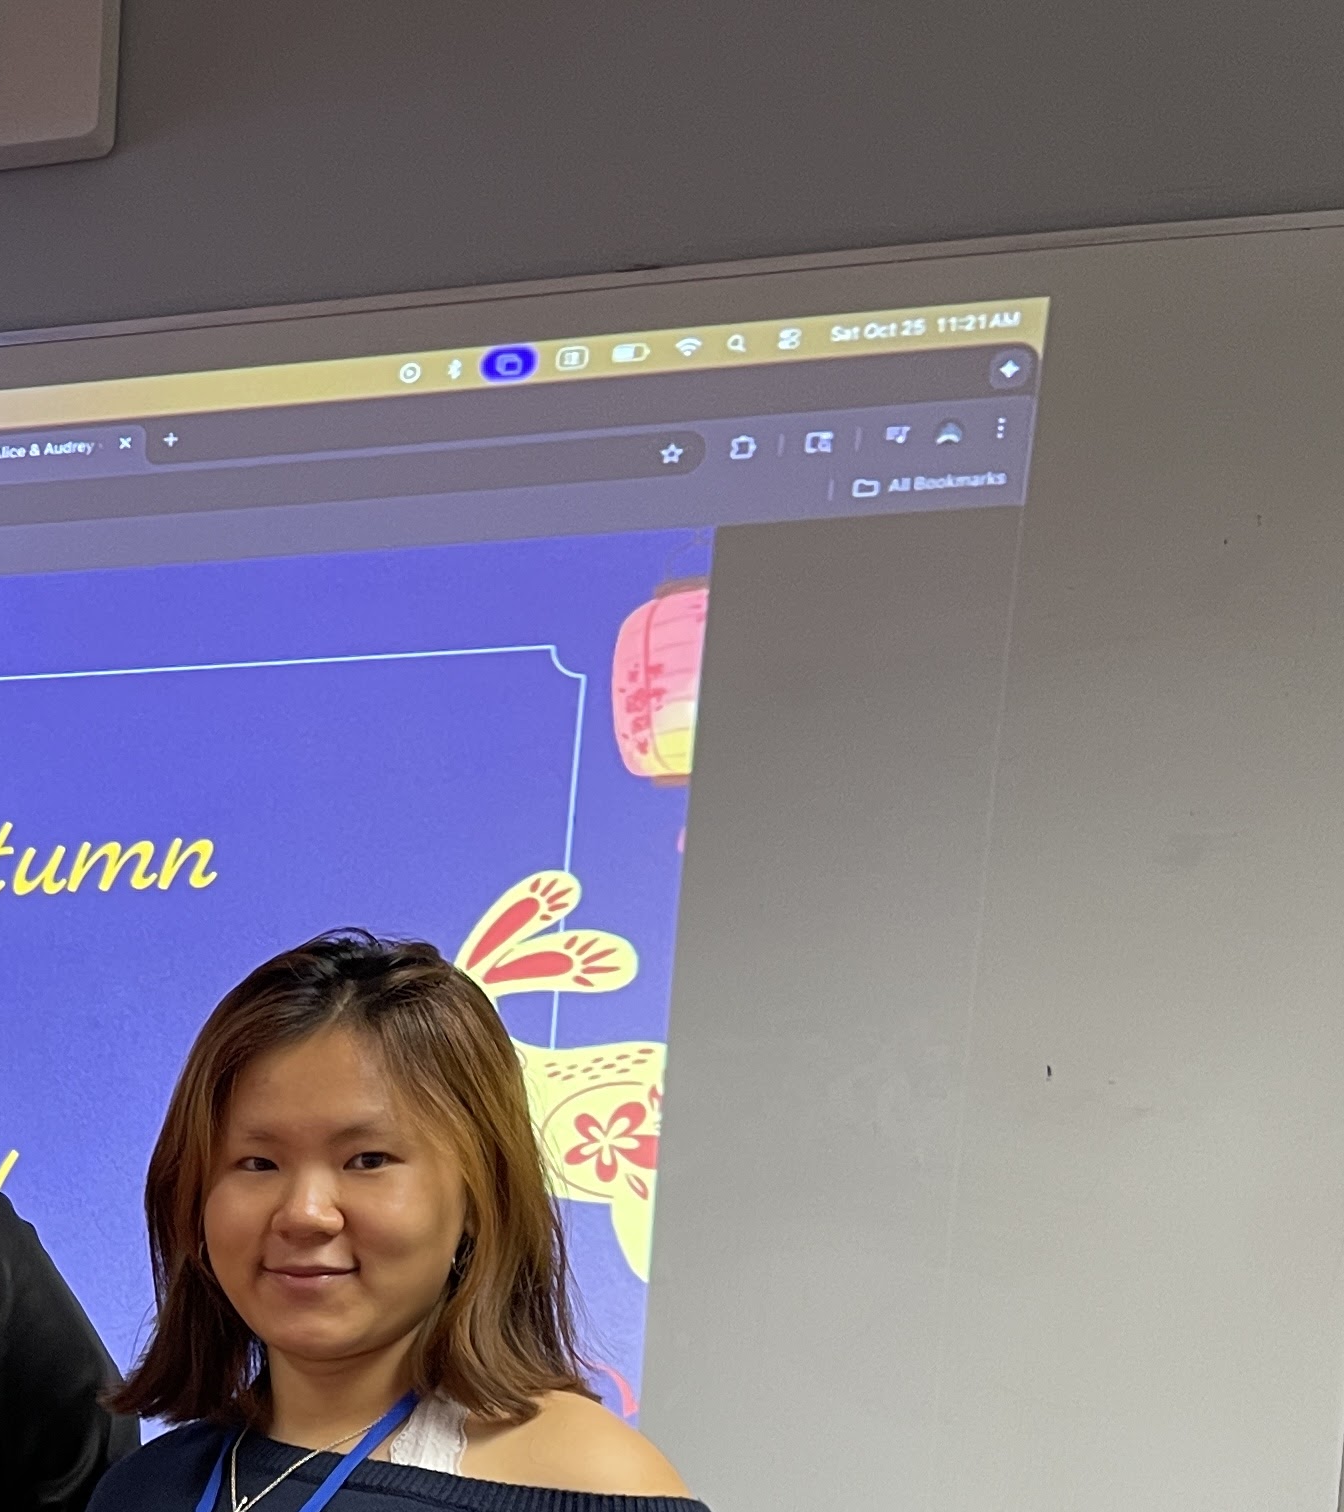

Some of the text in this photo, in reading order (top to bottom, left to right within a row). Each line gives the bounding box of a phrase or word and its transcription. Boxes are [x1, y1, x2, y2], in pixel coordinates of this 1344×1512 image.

[831, 312, 1021, 342] Sat Oct 25 11:21 AM
[44, 441, 95, 456] Audrey
[913, 472, 1007, 490] Bookmarks
